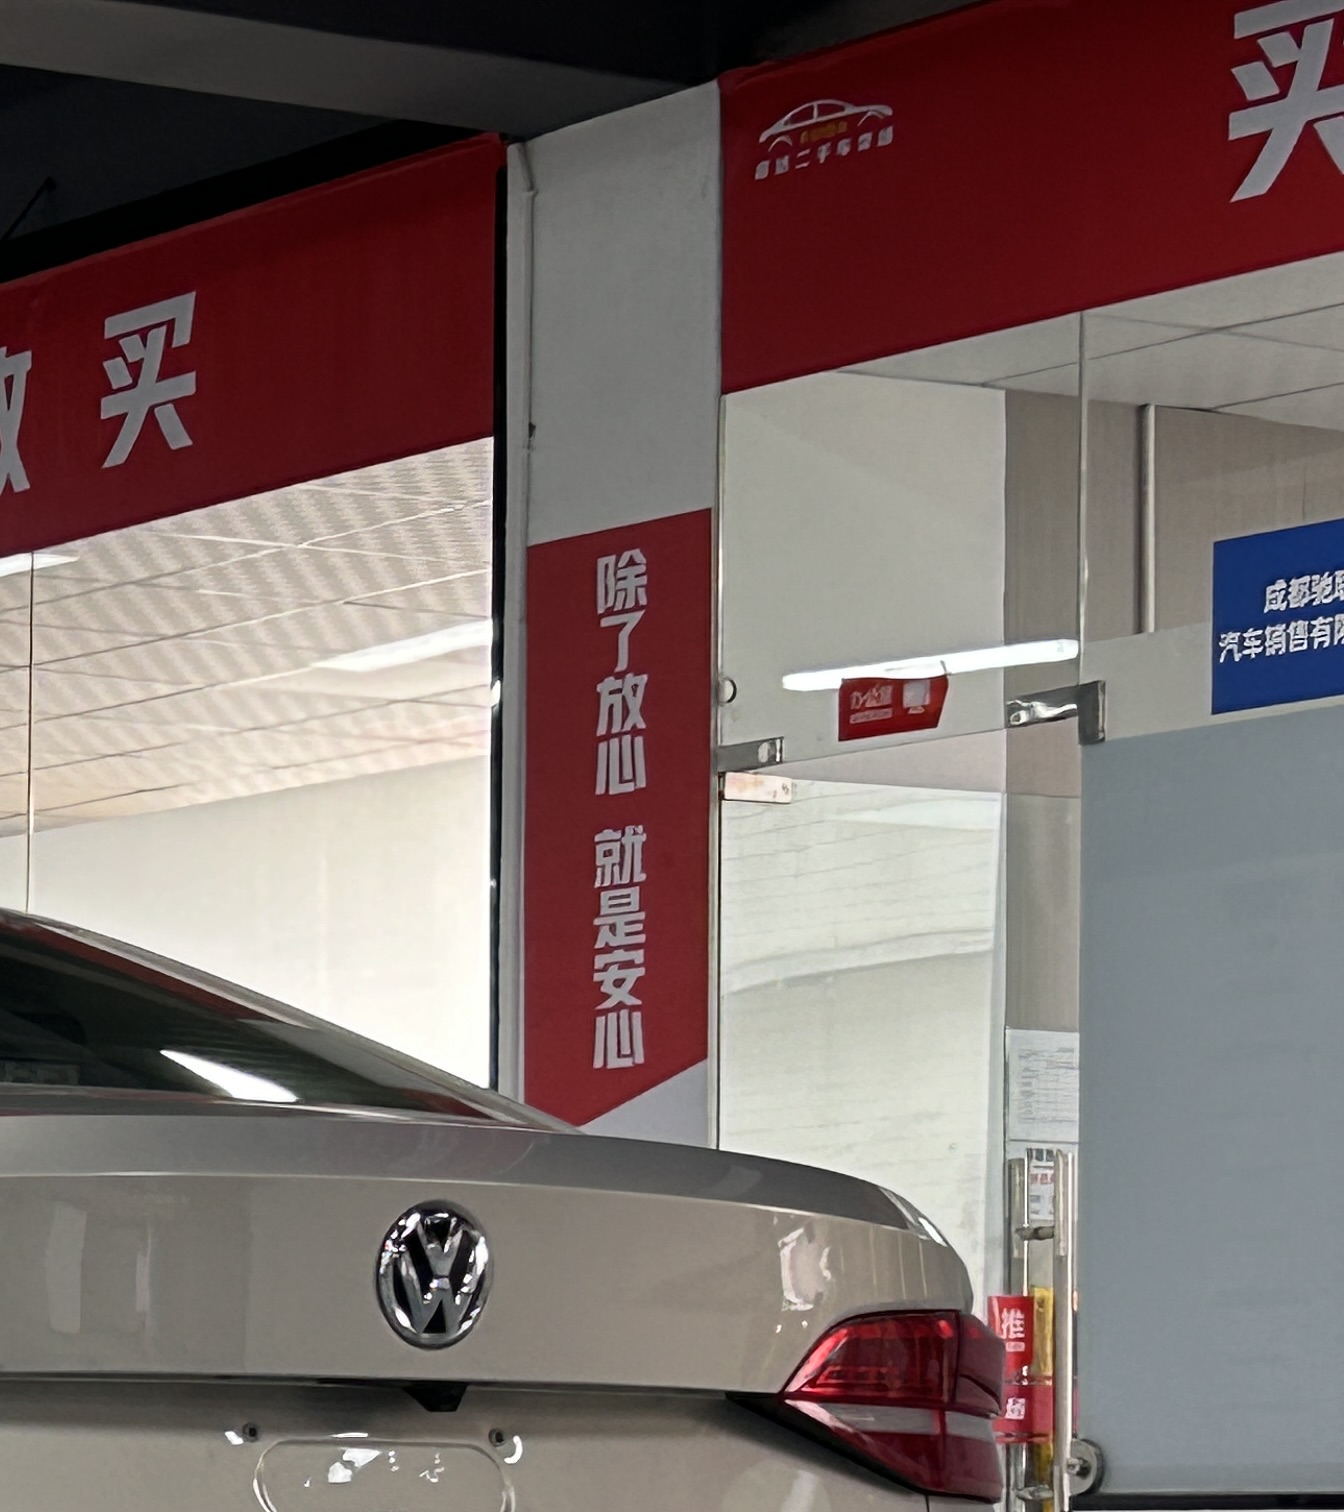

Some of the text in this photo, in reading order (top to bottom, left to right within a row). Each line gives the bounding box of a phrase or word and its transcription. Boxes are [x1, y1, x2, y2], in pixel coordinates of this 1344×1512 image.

[1228, 0, 1344, 203] 买
[593, 548, 648, 1069] 除了放心 就是安心
